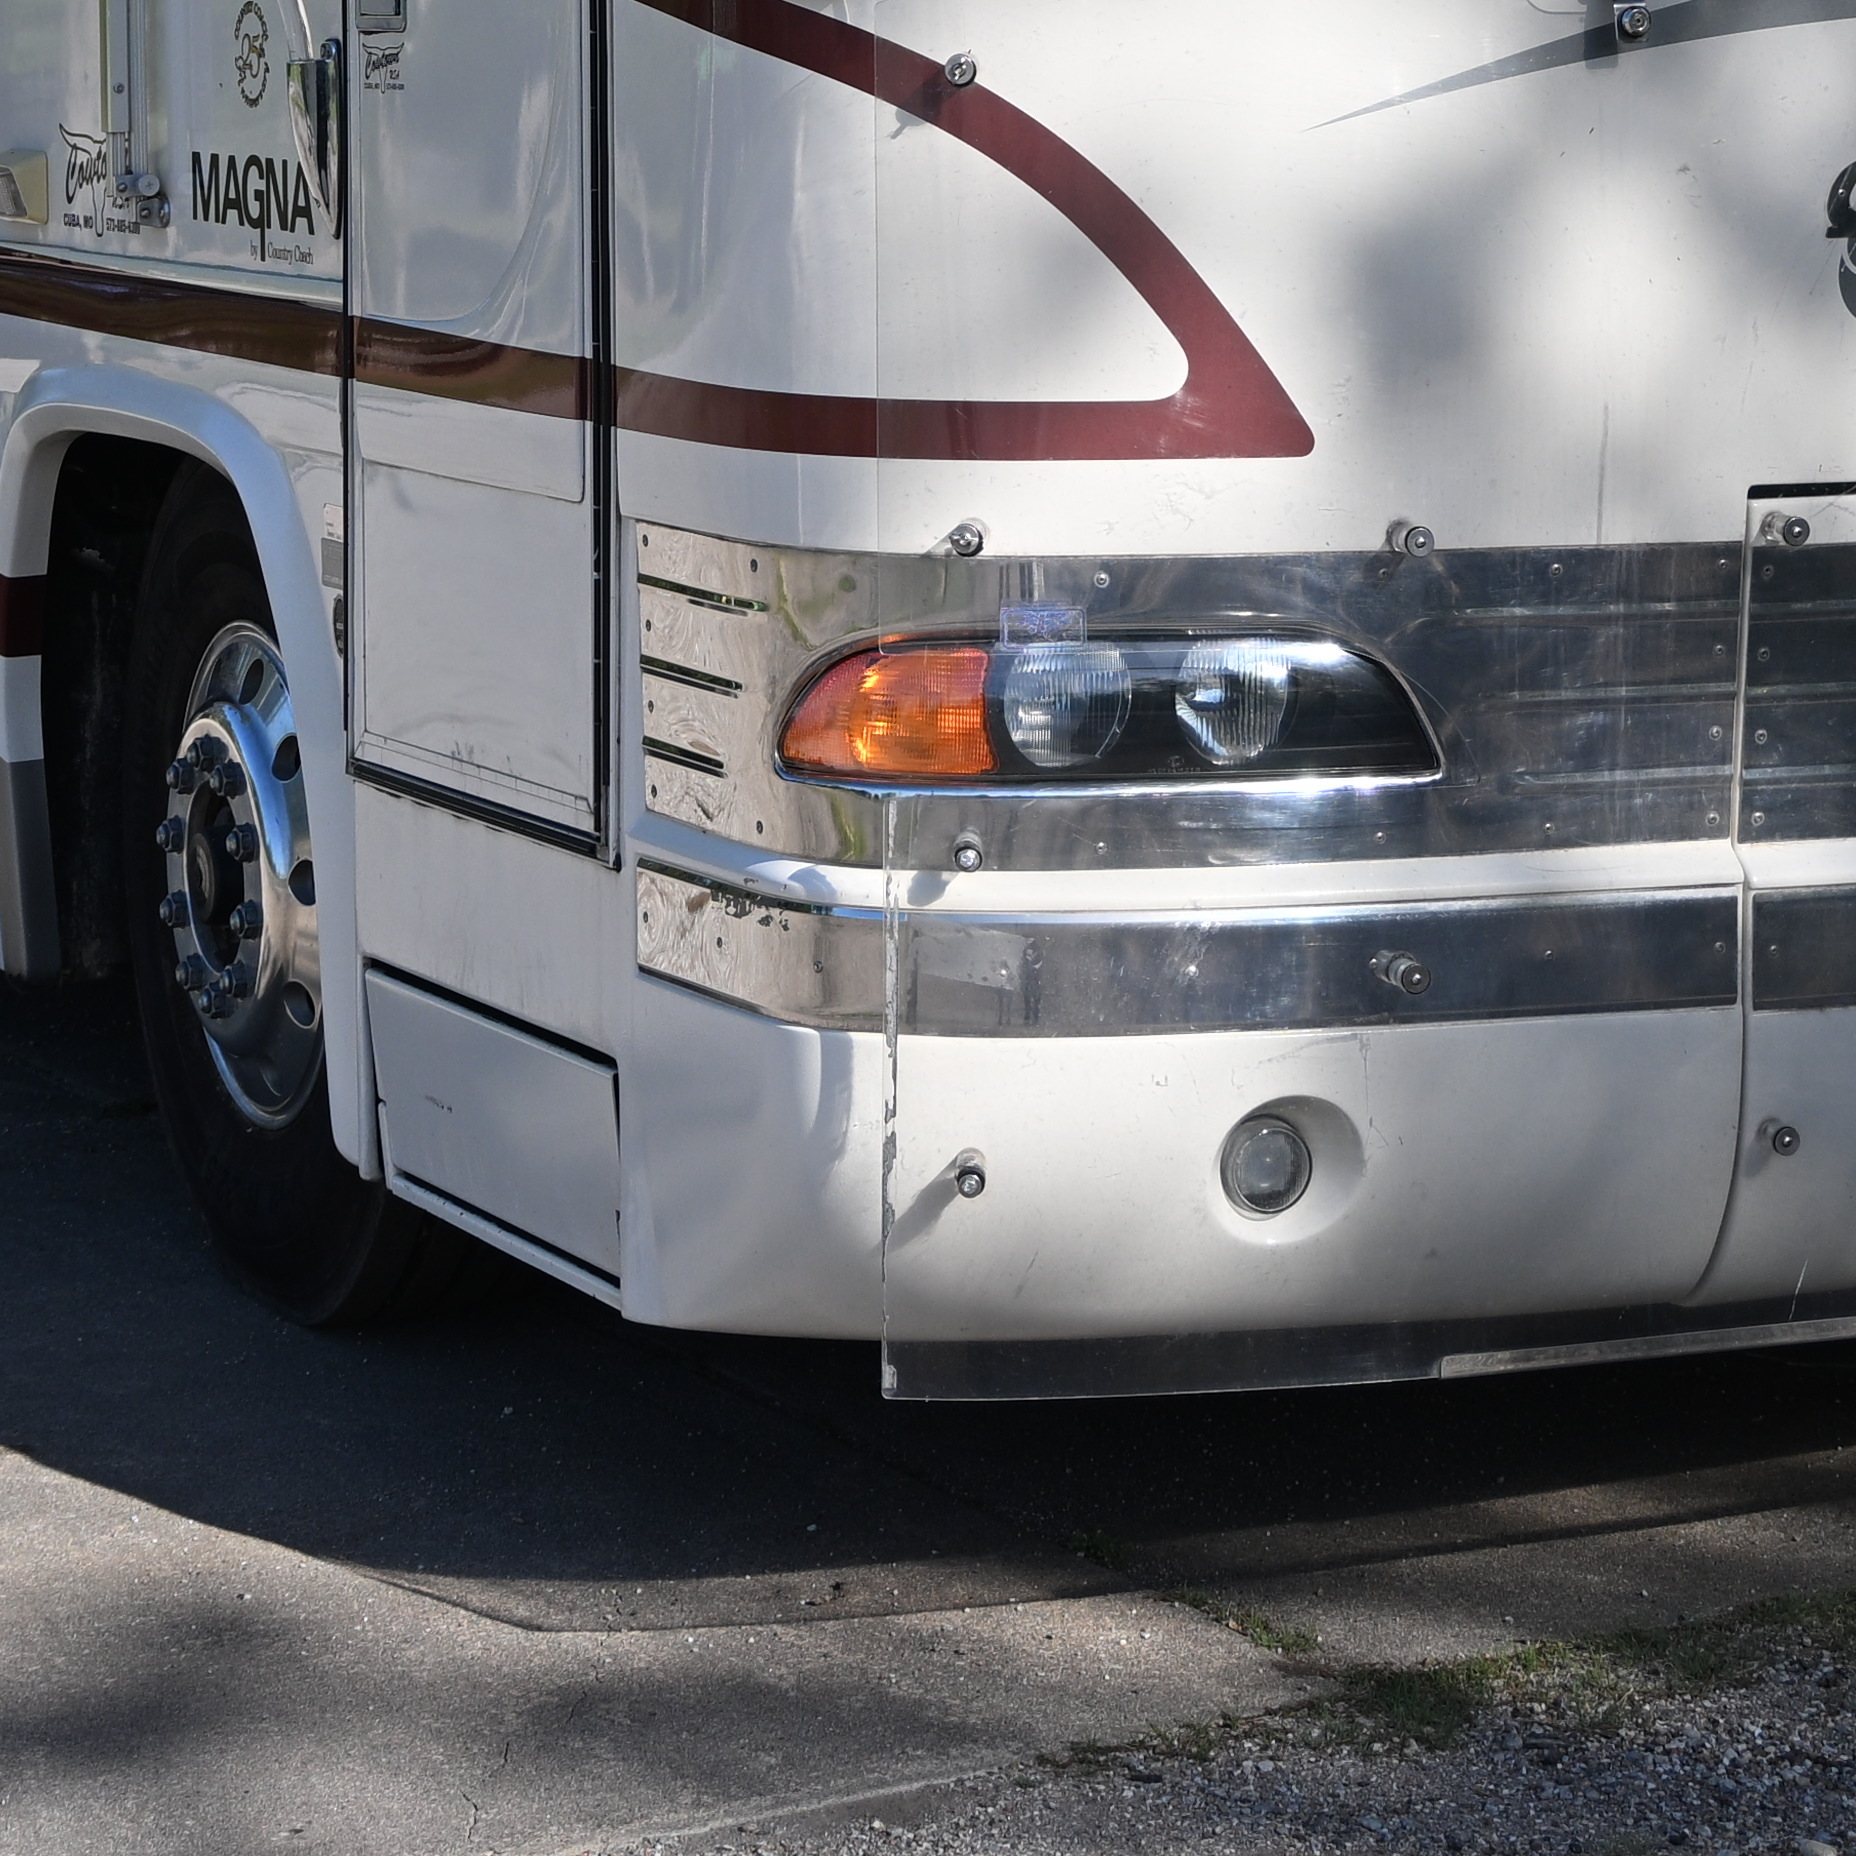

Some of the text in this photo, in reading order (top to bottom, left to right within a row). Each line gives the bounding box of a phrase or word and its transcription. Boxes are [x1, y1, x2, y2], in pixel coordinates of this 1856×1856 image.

[191, 151, 315, 262] MAGNA
[250, 240, 314, 265] by Country Coach
